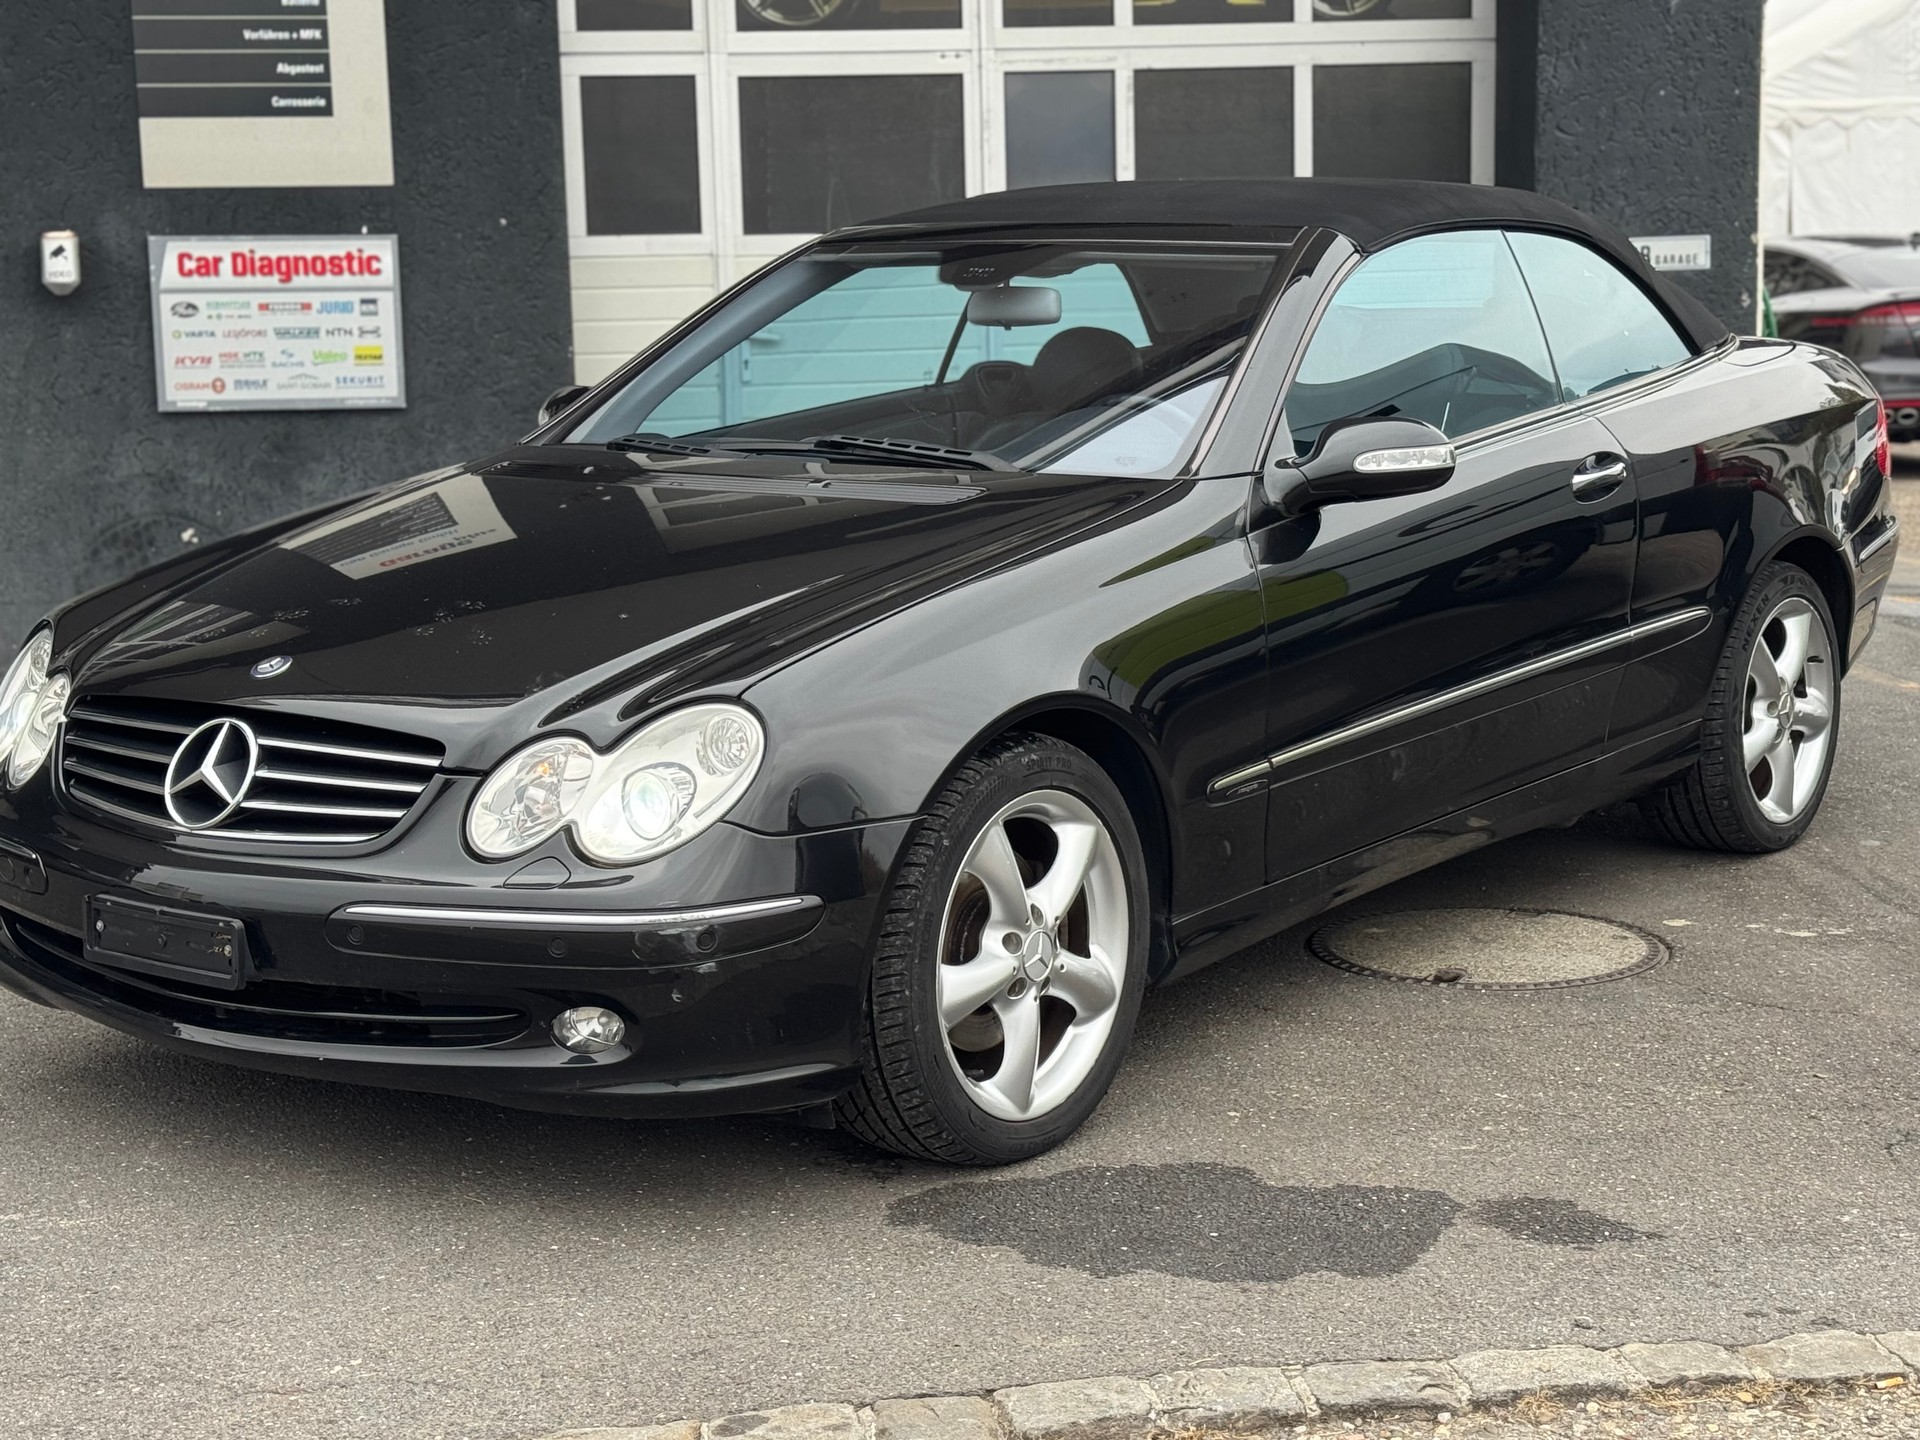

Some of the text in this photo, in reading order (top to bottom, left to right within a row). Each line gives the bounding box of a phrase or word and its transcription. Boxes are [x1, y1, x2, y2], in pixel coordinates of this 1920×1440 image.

[299, 28, 322, 40] MFK
[276, 62, 324, 75] Abgastest
[271, 96, 326, 107] Carrosserie
[1655, 253, 1698, 265] GARAGE
[177, 248, 382, 284] Car Diagnostic
[184, 330, 216, 338] VARTA
[336, 376, 385, 385] SEKURIT
[1741, 594, 1769, 652] NEXEN
